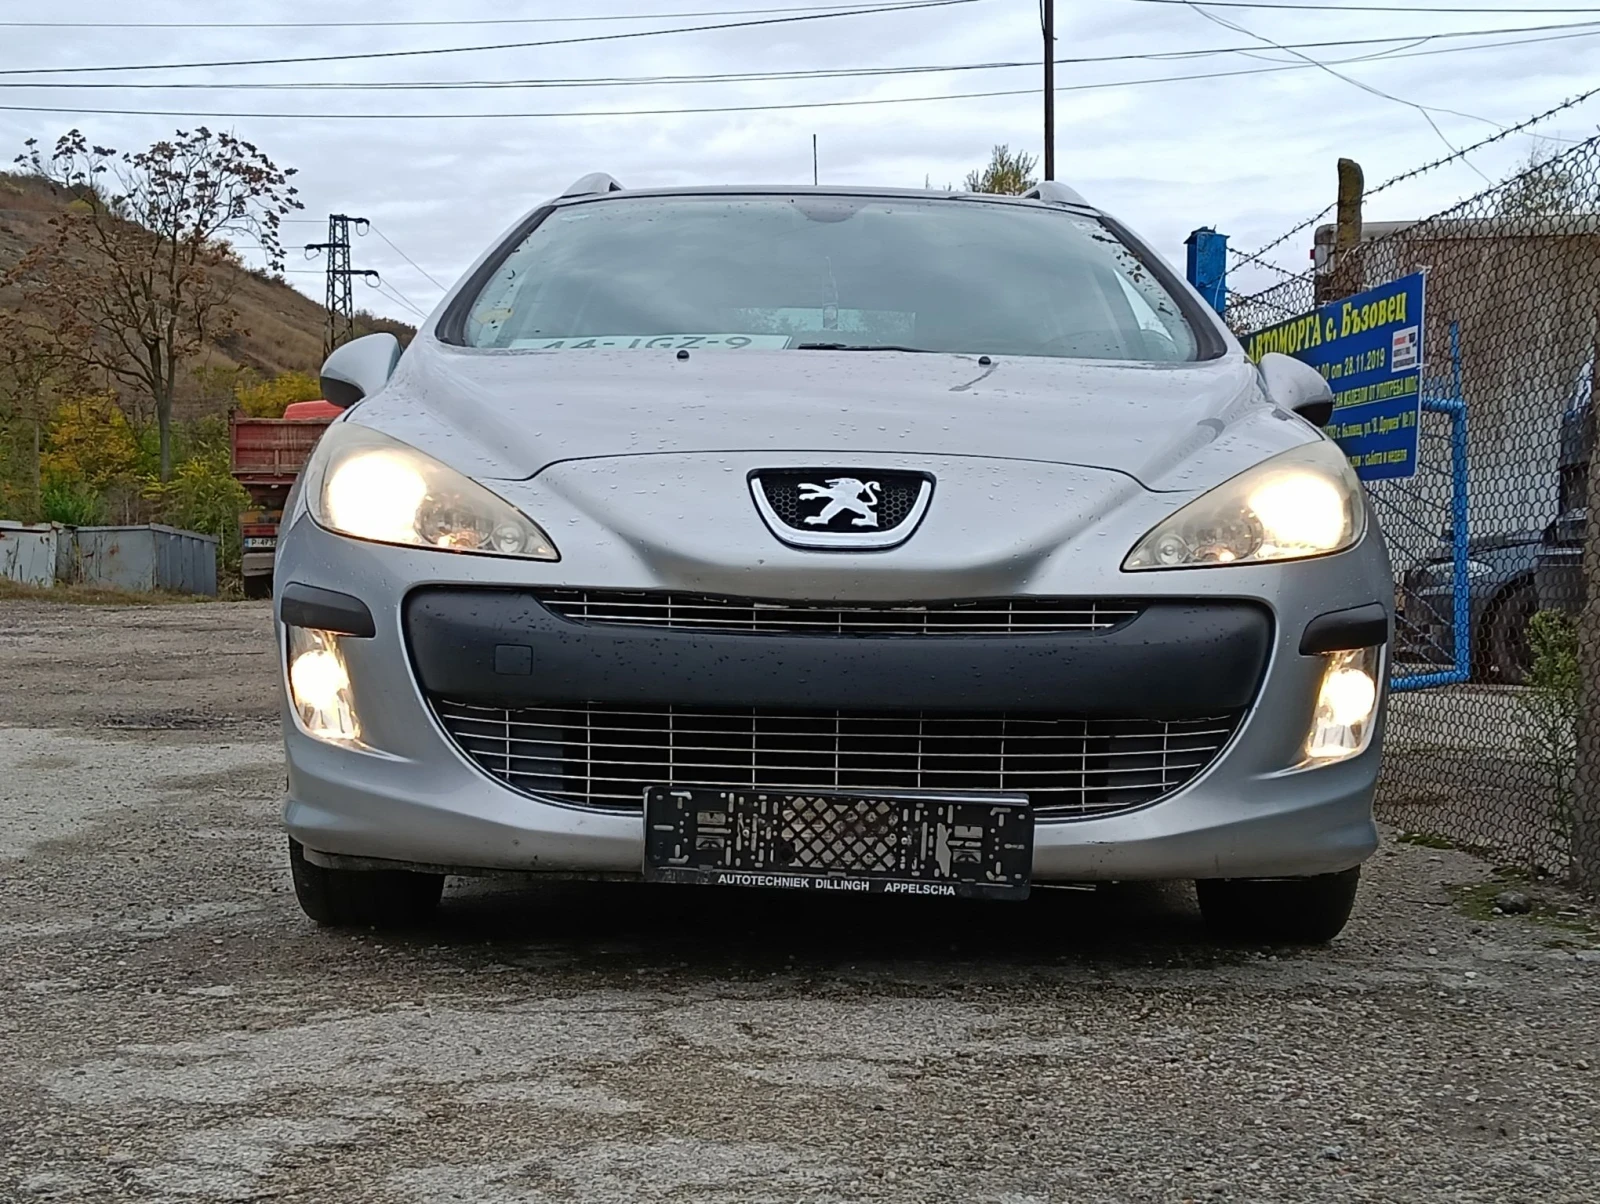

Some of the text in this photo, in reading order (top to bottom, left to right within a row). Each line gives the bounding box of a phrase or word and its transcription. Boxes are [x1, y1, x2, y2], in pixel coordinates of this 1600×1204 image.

[1326, 317, 1337, 342] с.
[1340, 292, 1407, 338] Бъзовец
[1344, 347, 1385, 377] 28.11.2019
[718, 873, 956, 896] AUTOTECHNIEK DILLINGH APPELSCHA
